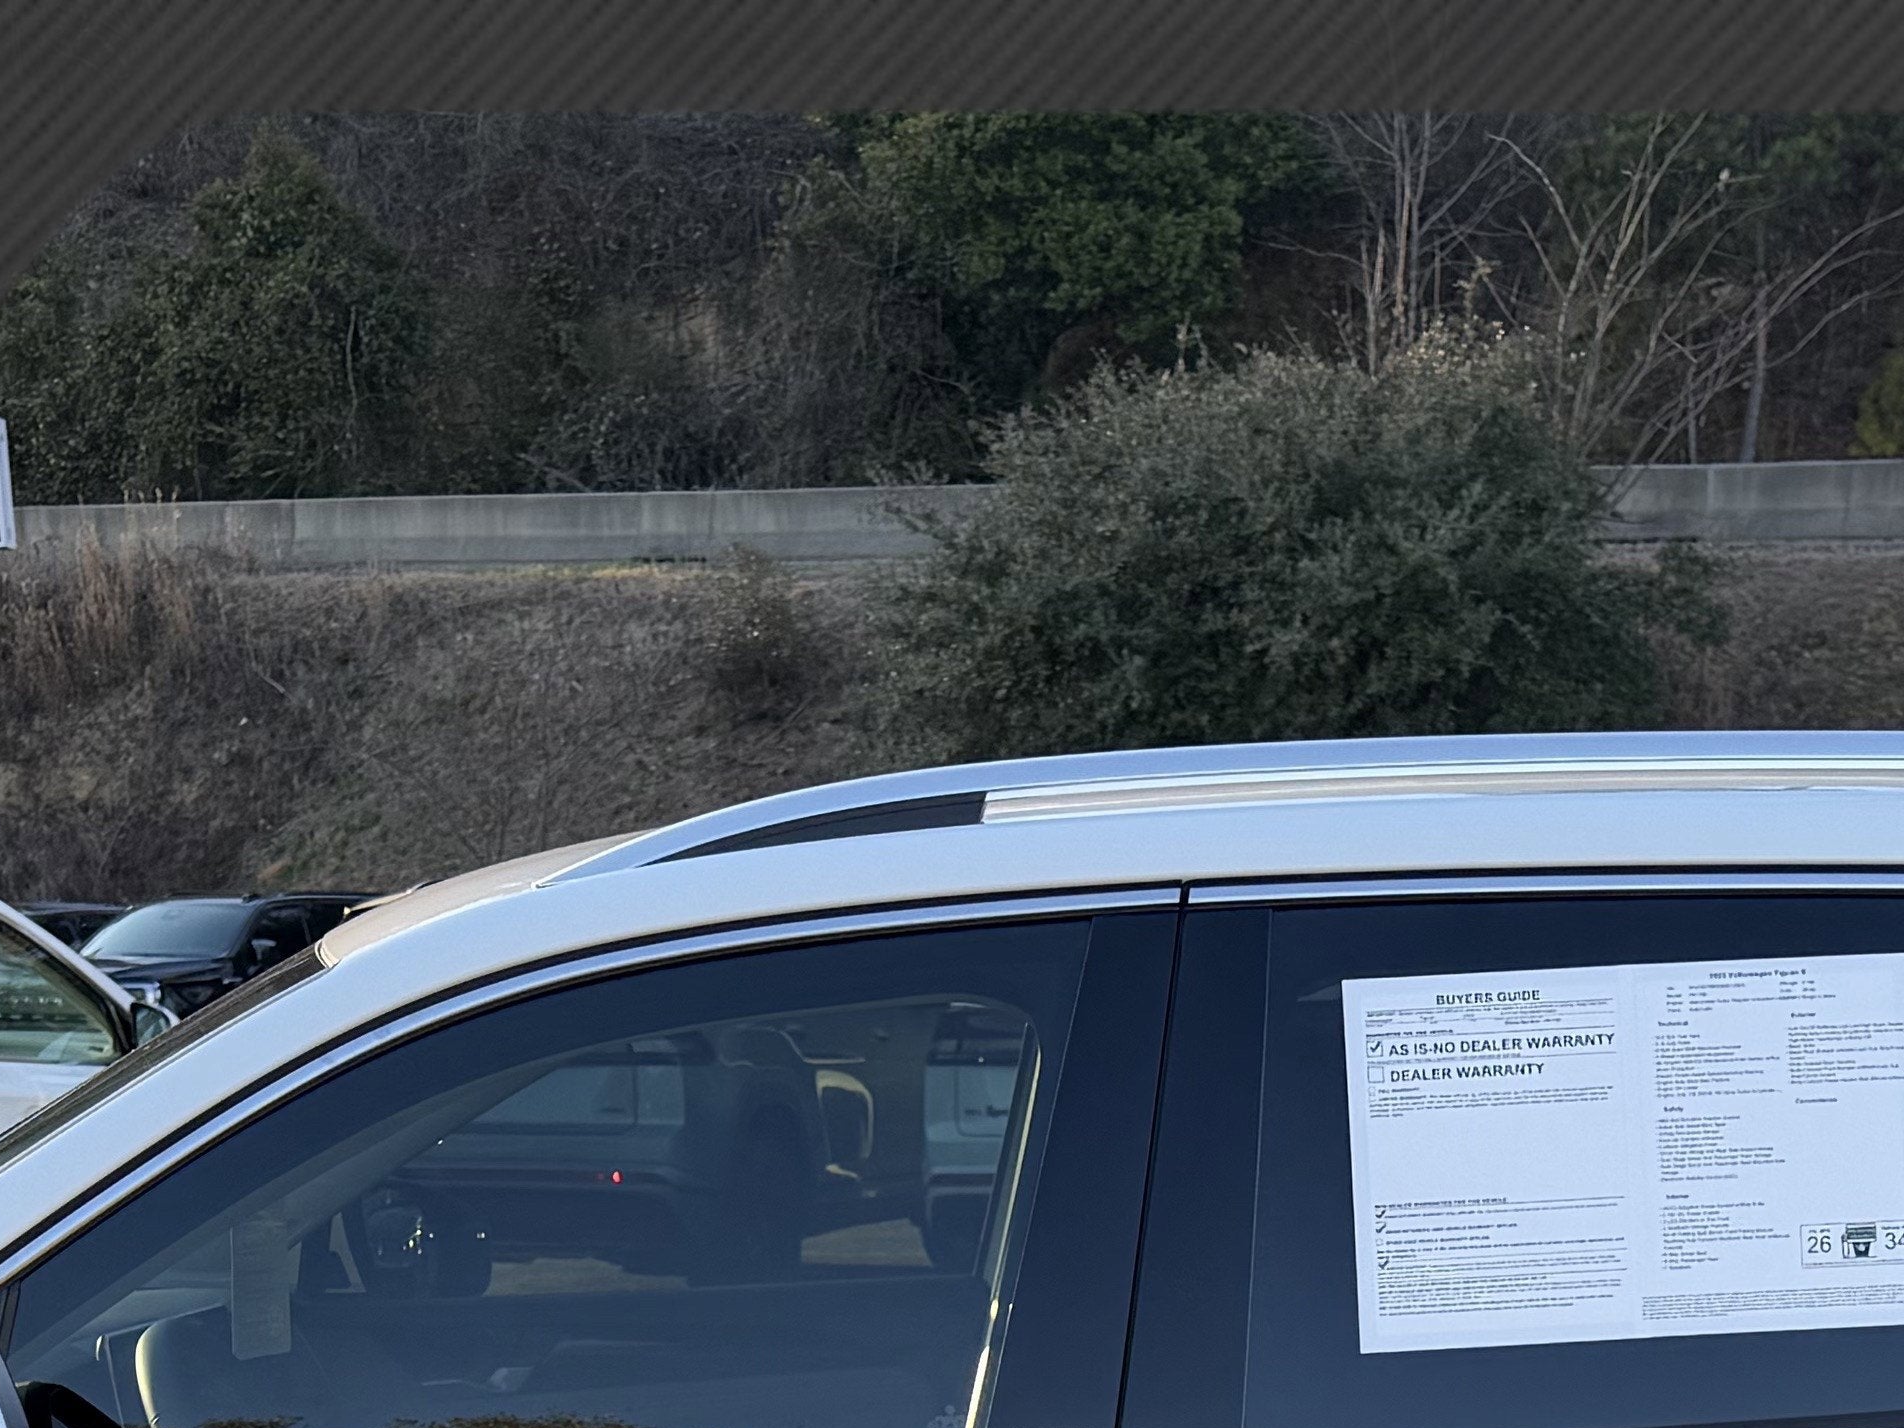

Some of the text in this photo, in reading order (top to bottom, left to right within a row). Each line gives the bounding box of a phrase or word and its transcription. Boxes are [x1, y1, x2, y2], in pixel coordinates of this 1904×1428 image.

[1436, 989, 1541, 1005] BUYERS GUIDE
[1388, 1043, 1410, 1057] AS
[1460, 1037, 1523, 1053] DEALER
[1390, 1067, 1452, 1083] DEALER
[1807, 1235, 1832, 1254] 26
